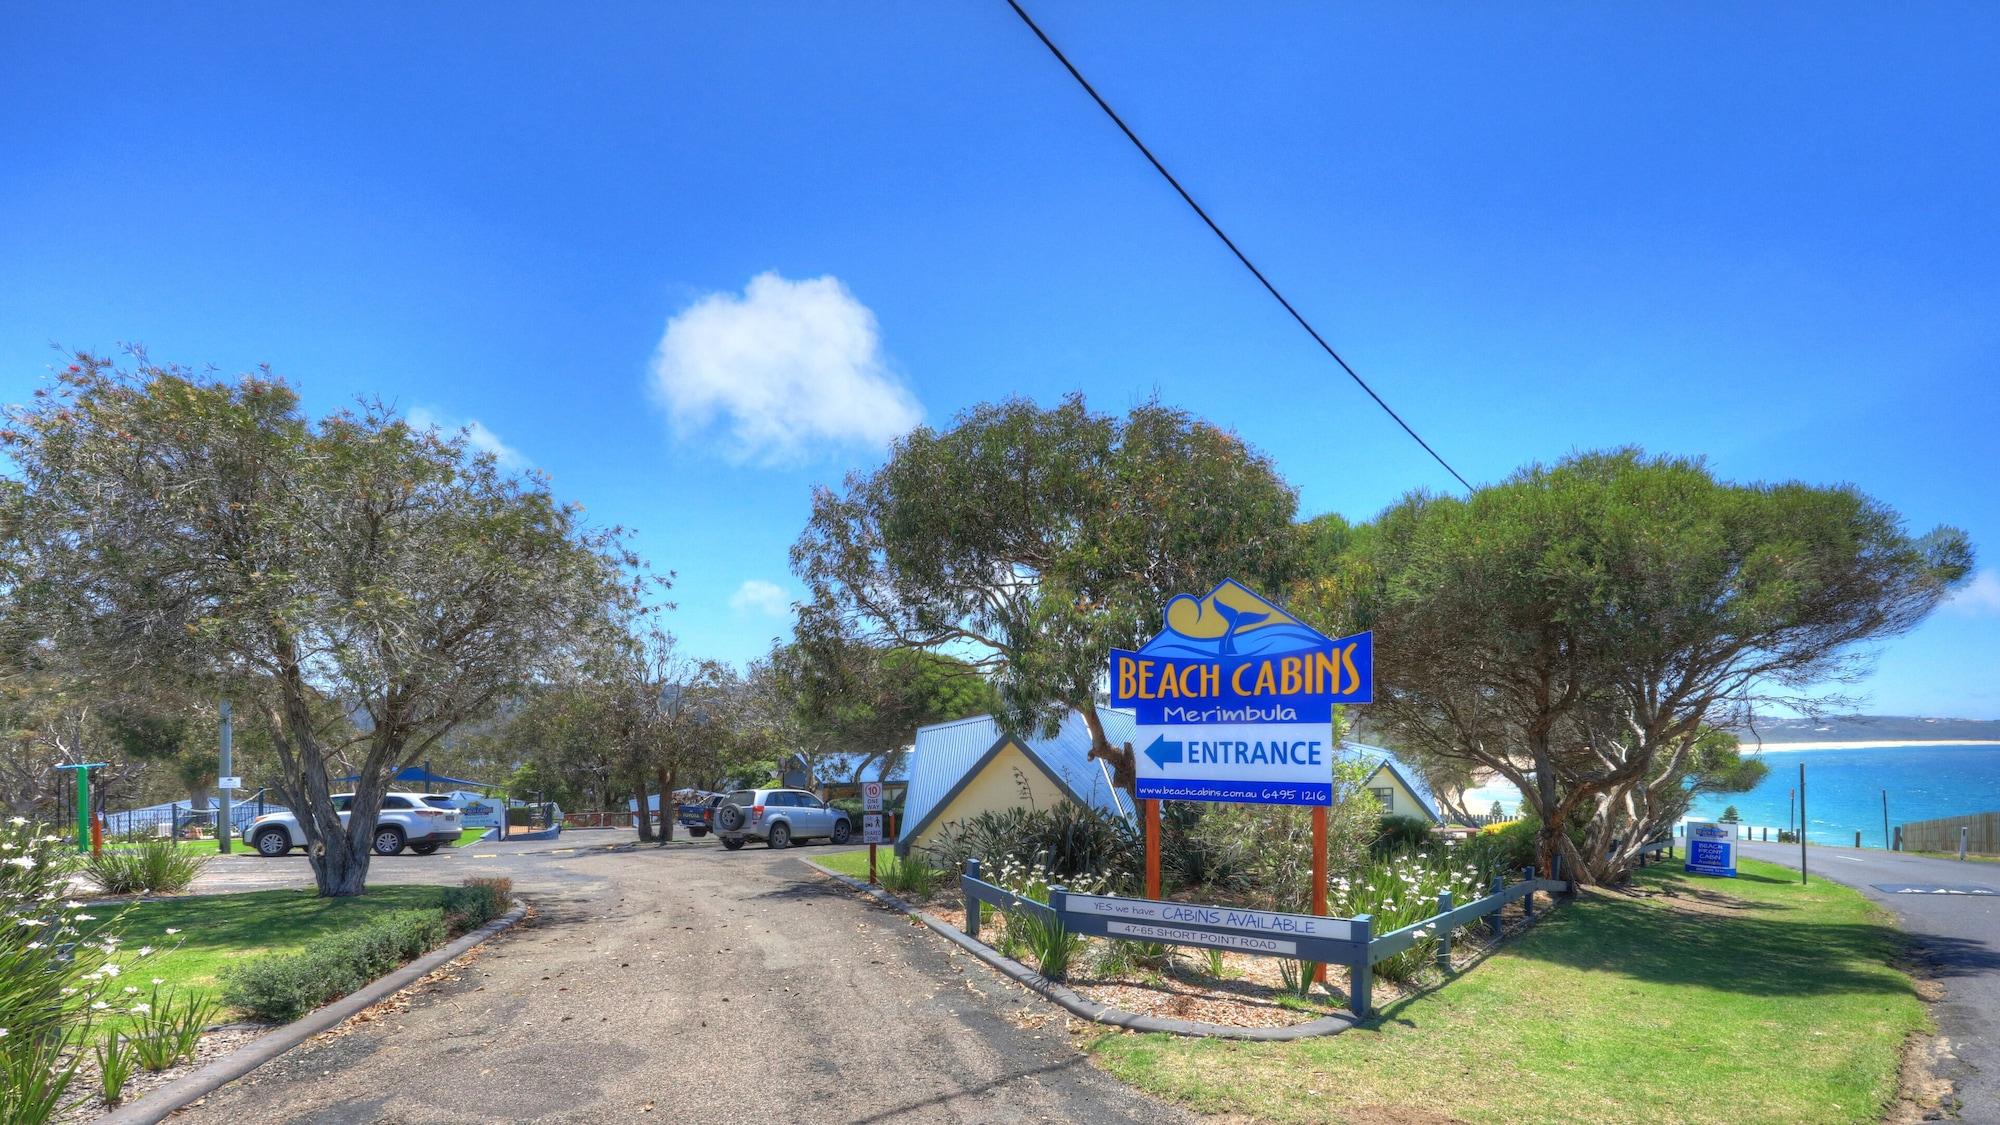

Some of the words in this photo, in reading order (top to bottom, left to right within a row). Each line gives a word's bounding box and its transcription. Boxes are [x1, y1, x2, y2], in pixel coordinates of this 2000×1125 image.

[1118, 657, 1220, 699] BEACH
[1231, 642, 1361, 696] CABINS
[1163, 704, 1298, 723] Merimbula
[1188, 741, 1321, 765] ENTRANCE
[867, 786, 878, 796] 10
[1139, 786, 1257, 798] www.beachcabins.com.au
[1261, 788, 1296, 800] 6495
[1301, 790, 1326, 801] 1216
[1094, 902, 1113, 912] YES
[1115, 905, 1129, 913] we
[1132, 905, 1155, 916] have
[1162, 907, 1220, 923] CABINS
[1226, 912, 1316, 934] AVAILABLE
[1124, 925, 1154, 935] 47-65
[1157, 928, 1197, 940] SHORT
[1200, 933, 1237, 945] POINT
[1240, 938, 1277, 950] ROAD
